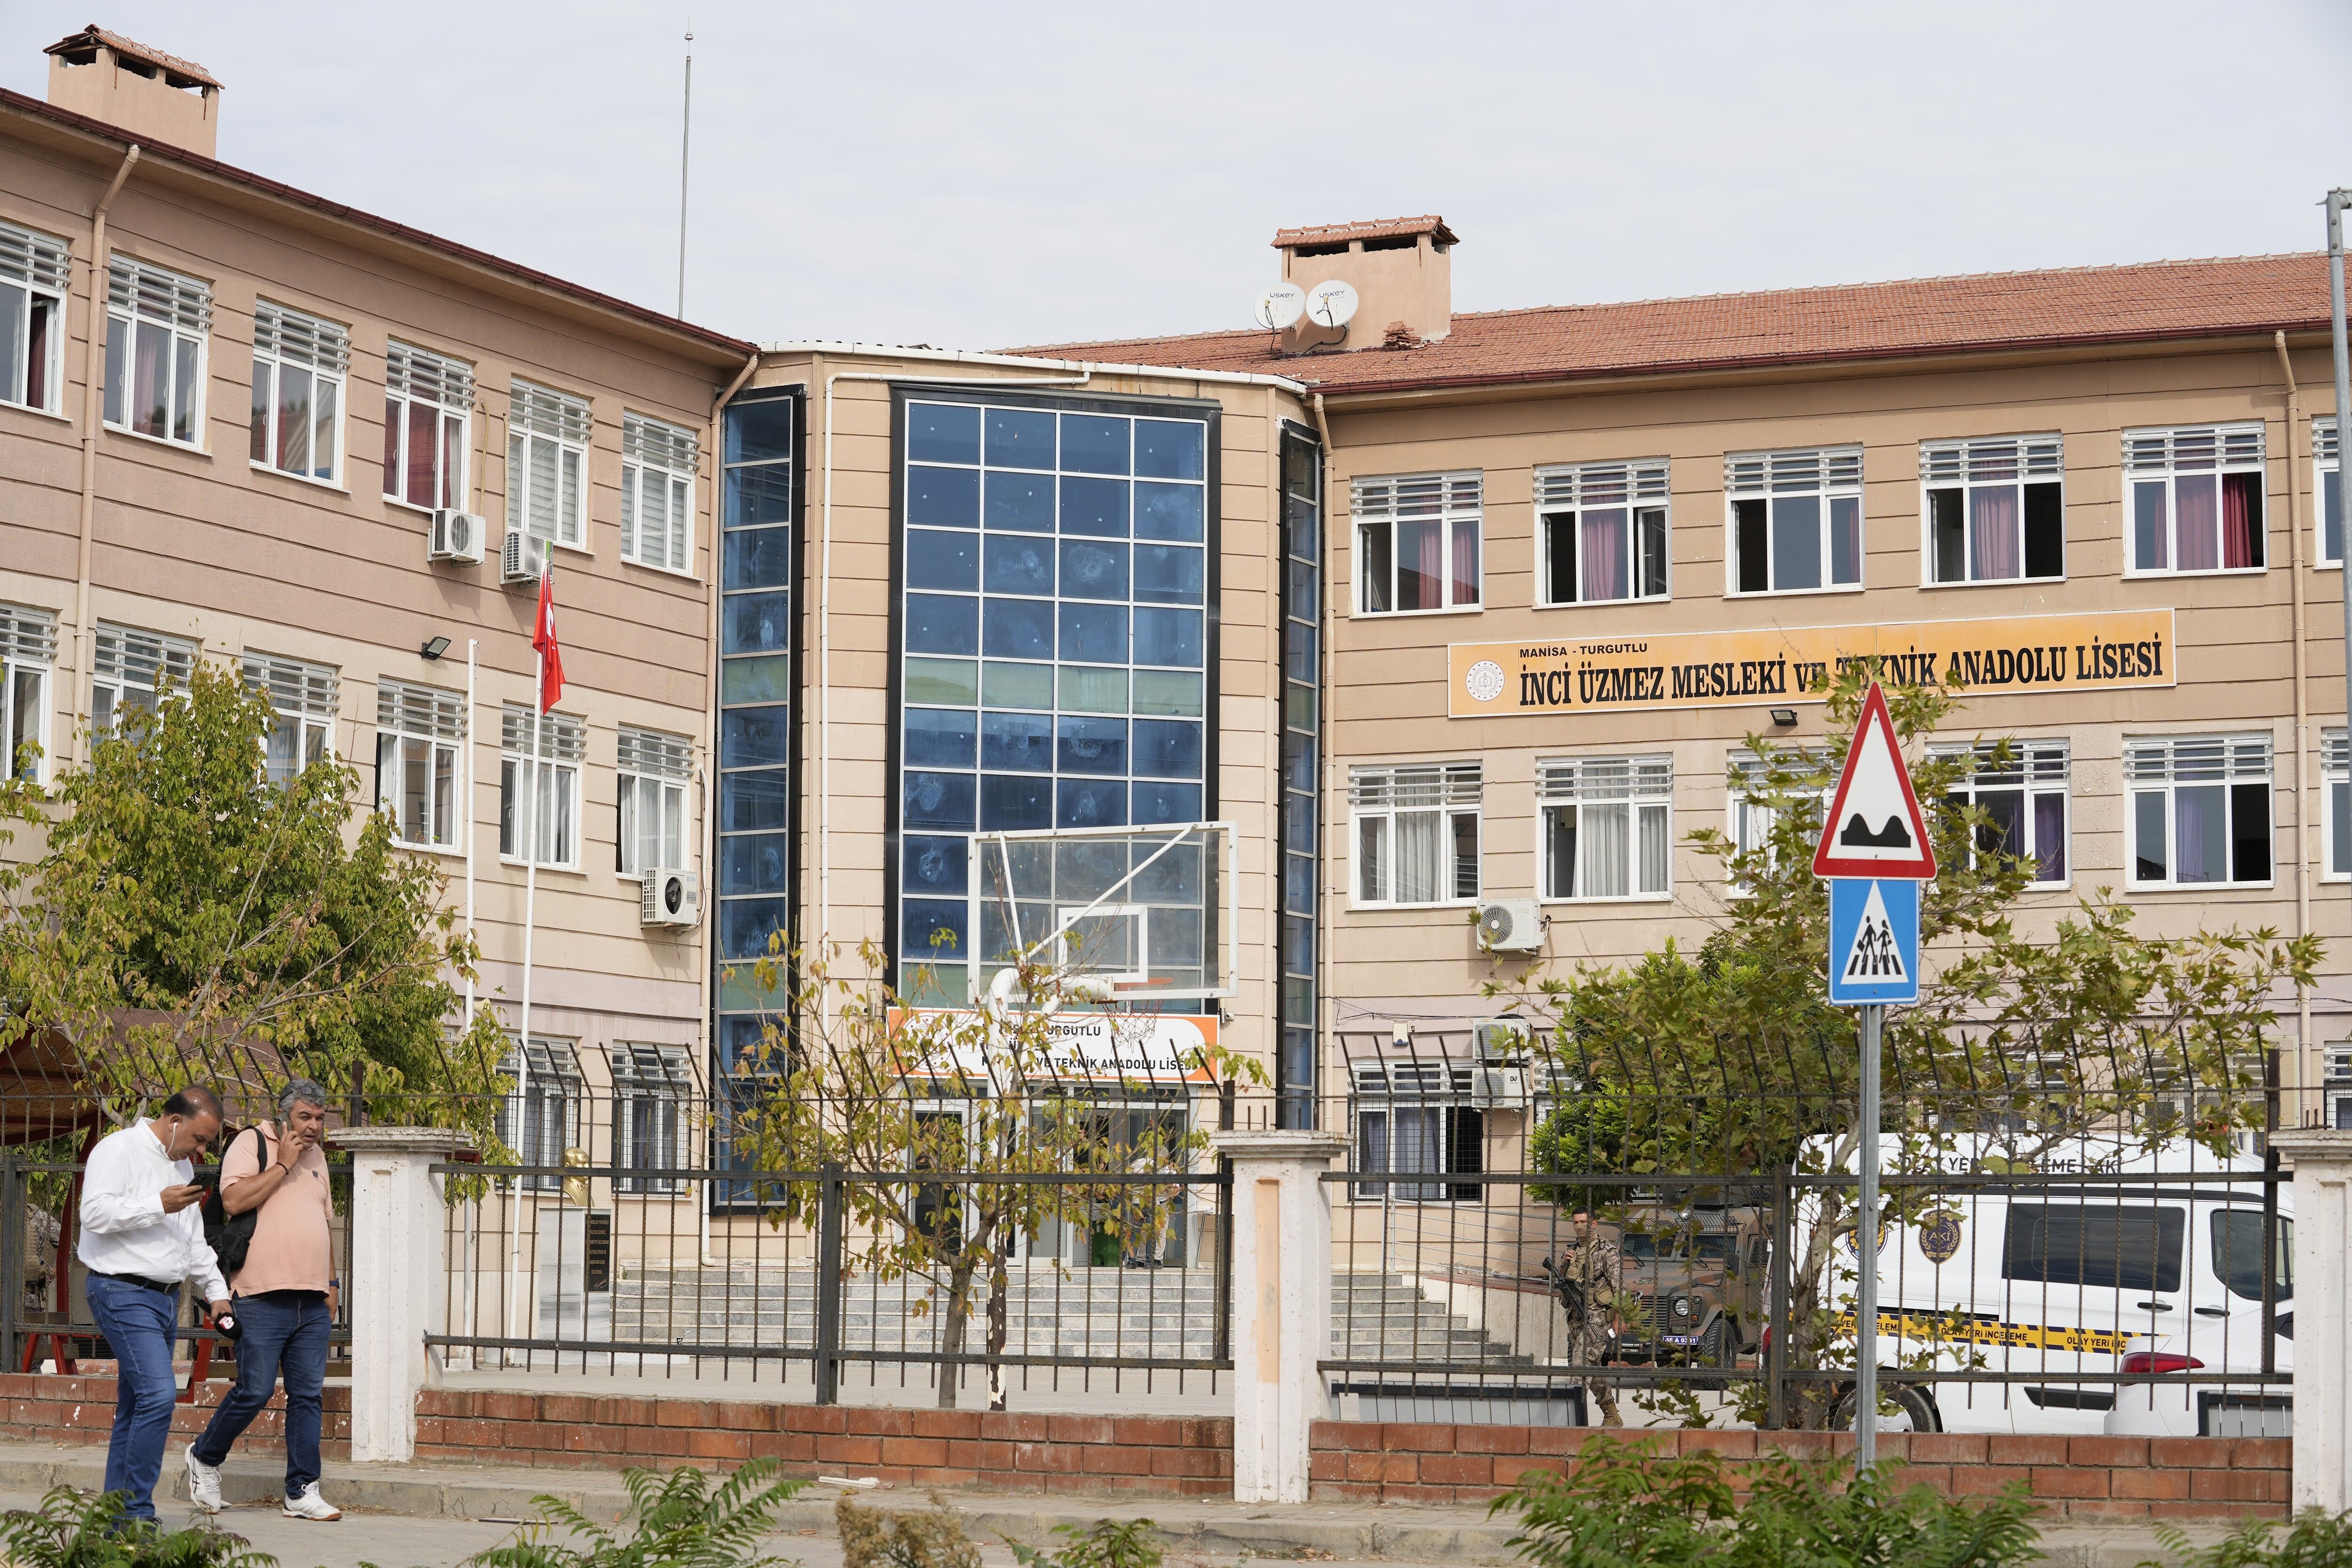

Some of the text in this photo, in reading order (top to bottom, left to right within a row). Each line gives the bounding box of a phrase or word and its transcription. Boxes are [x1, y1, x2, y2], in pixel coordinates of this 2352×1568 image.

[1520, 645, 1567, 658] MANİSA
[1580, 643, 1647, 655] TURGUTLU
[1520, 662, 1572, 706] İNCİ
[1578, 661, 1664, 704] ÜZMEZ
[1671, 651, 1787, 699] MESLEKİ
[1947, 647, 2067, 685] ANADOLU
[2076, 632, 2163, 680] LİSESİ
[1046, 1026, 1101, 1036] URGUTLU
[1054, 1056, 1097, 1068] TEKNİK
[1101, 1059, 1156, 1069] ANADOLU
[1160, 1057, 1196, 1070] LİSE
[1929, 1231, 1951, 1241] AKİ
[2067, 1337, 2090, 1346] OLAY
